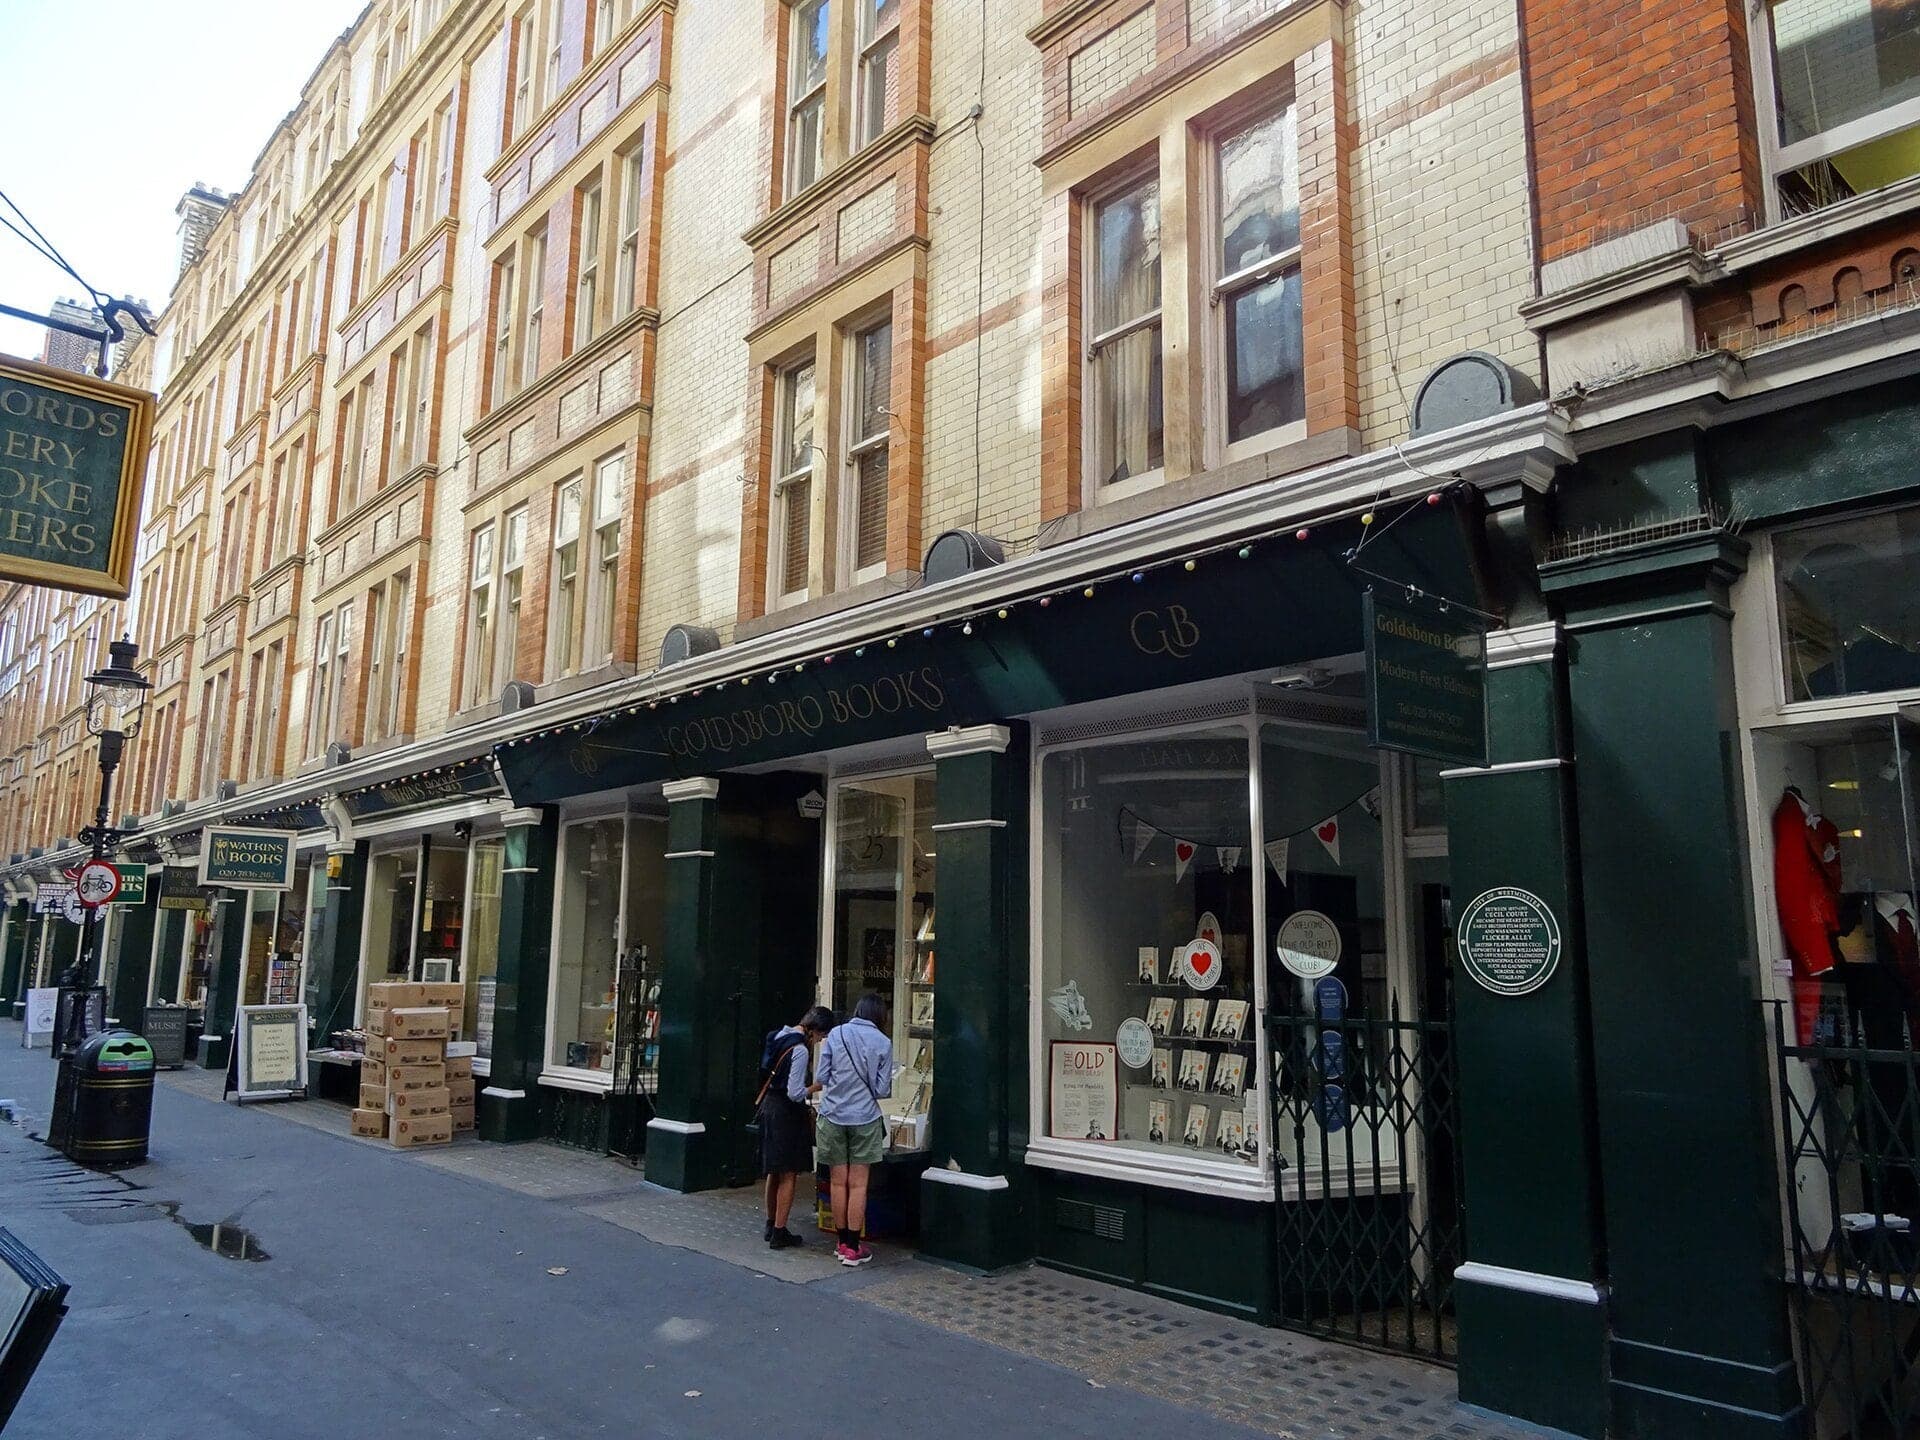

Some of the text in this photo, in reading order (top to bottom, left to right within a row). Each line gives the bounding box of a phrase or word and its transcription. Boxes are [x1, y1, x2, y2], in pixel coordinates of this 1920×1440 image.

[1, 389, 121, 437] ORDS
[0, 428, 85, 470] ERY
[0, 507, 96, 554] ERS
[1130, 605, 1200, 658] GB
[1376, 614, 1441, 646] Goldsboro
[1379, 659, 1417, 681] Modern
[666, 666, 945, 759] GOLDSBORO BOOKS
[229, 841, 284, 853] WATKINS
[229, 851, 283, 866] BOOKS
[219, 869, 236, 877] 020
[1473, 898, 1485, 910] CITY
[1497, 890, 1541, 908] WESTMINSTER
[1064, 1051, 1104, 1070] THE OLD
